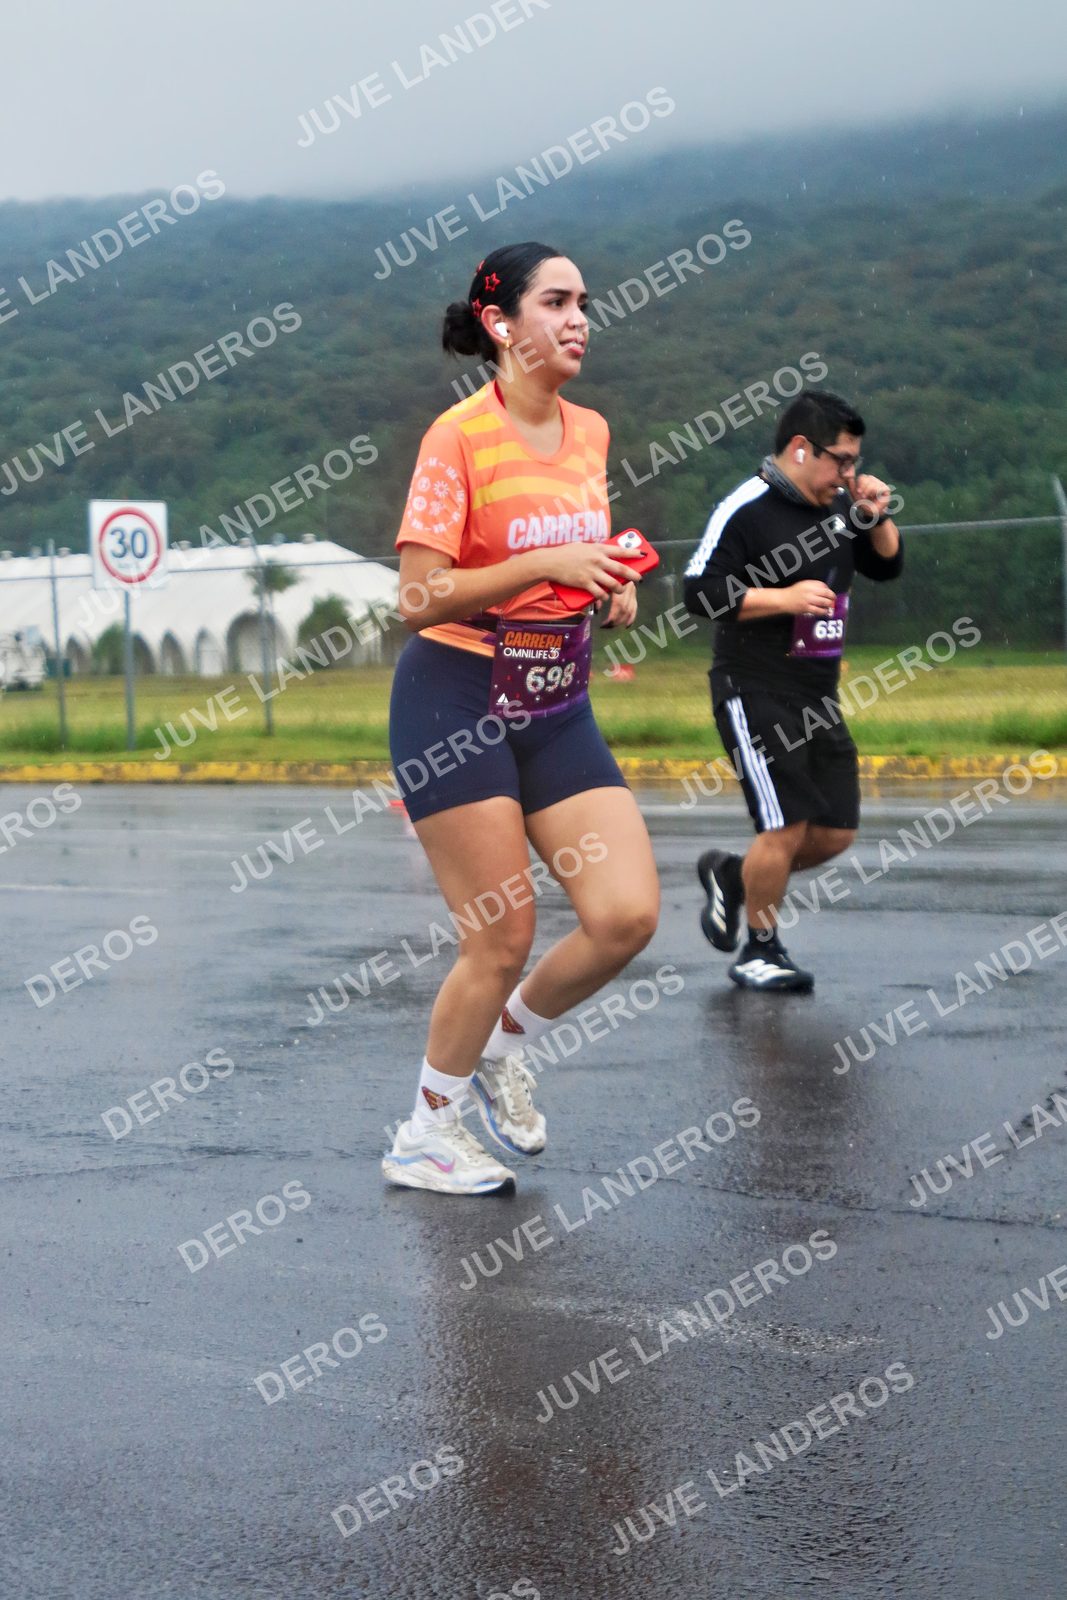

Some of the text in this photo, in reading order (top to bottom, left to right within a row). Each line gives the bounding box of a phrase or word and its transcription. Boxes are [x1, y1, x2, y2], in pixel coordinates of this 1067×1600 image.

[507, 510, 609, 549] CARRERA
[110, 528, 149, 559] 30
[504, 631, 564, 649] CARRERA
[814, 619, 844, 639] 653
[503, 647, 549, 660] OMNILIFE
[526, 661, 576, 693] 698
